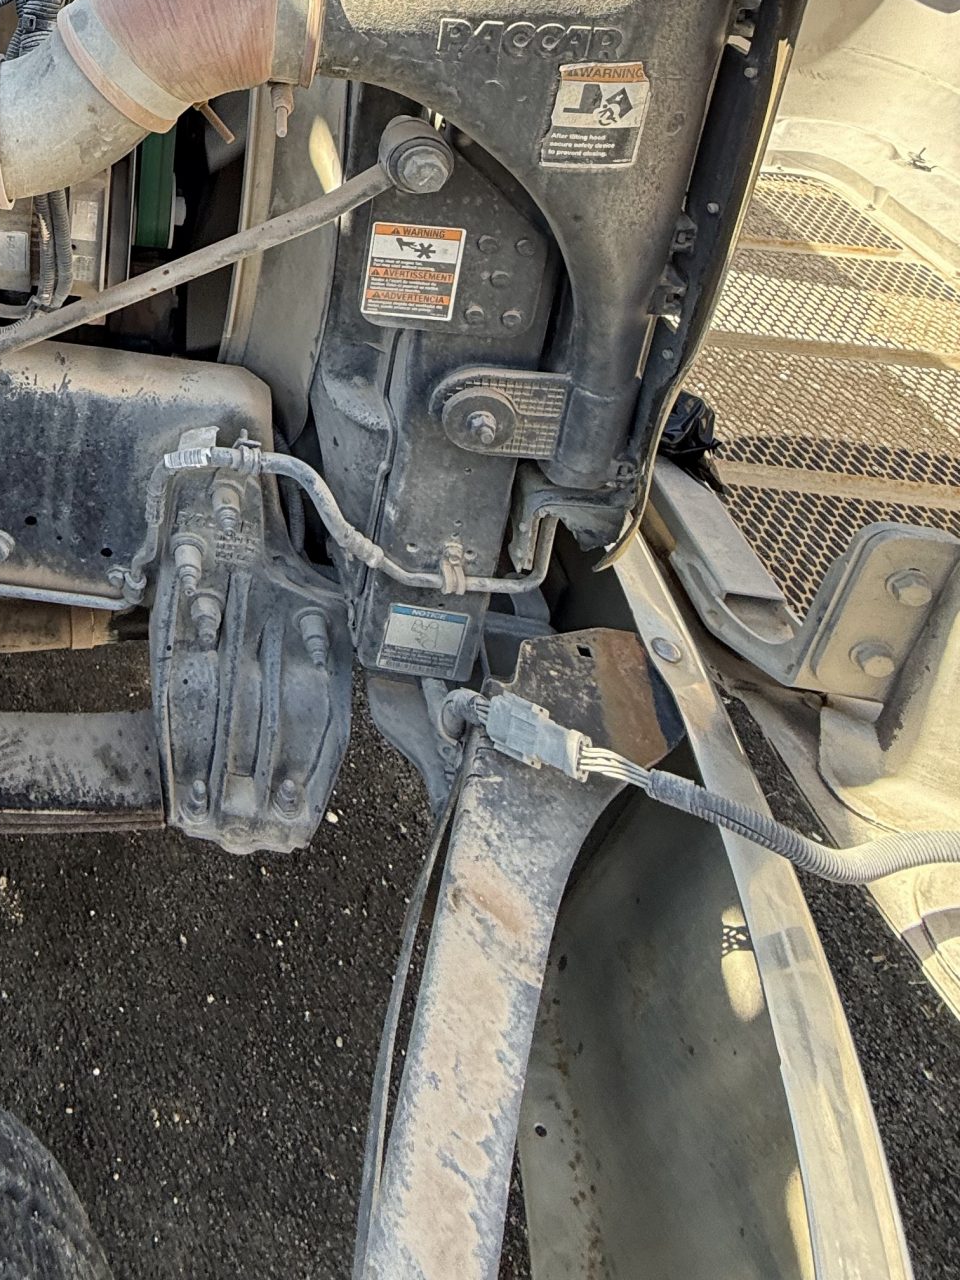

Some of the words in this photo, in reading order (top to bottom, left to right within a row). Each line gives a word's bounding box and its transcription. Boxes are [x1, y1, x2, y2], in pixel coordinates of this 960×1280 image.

[436, 18, 623, 61] PACCAR
[579, 66, 643, 79] WARNING
[403, 227, 446, 239] WARNING
[383, 269, 452, 282] AVERTISSEMENT
[384, 291, 444, 304] ADVERTENCIA
[411, 609, 447, 620] NOTICE
